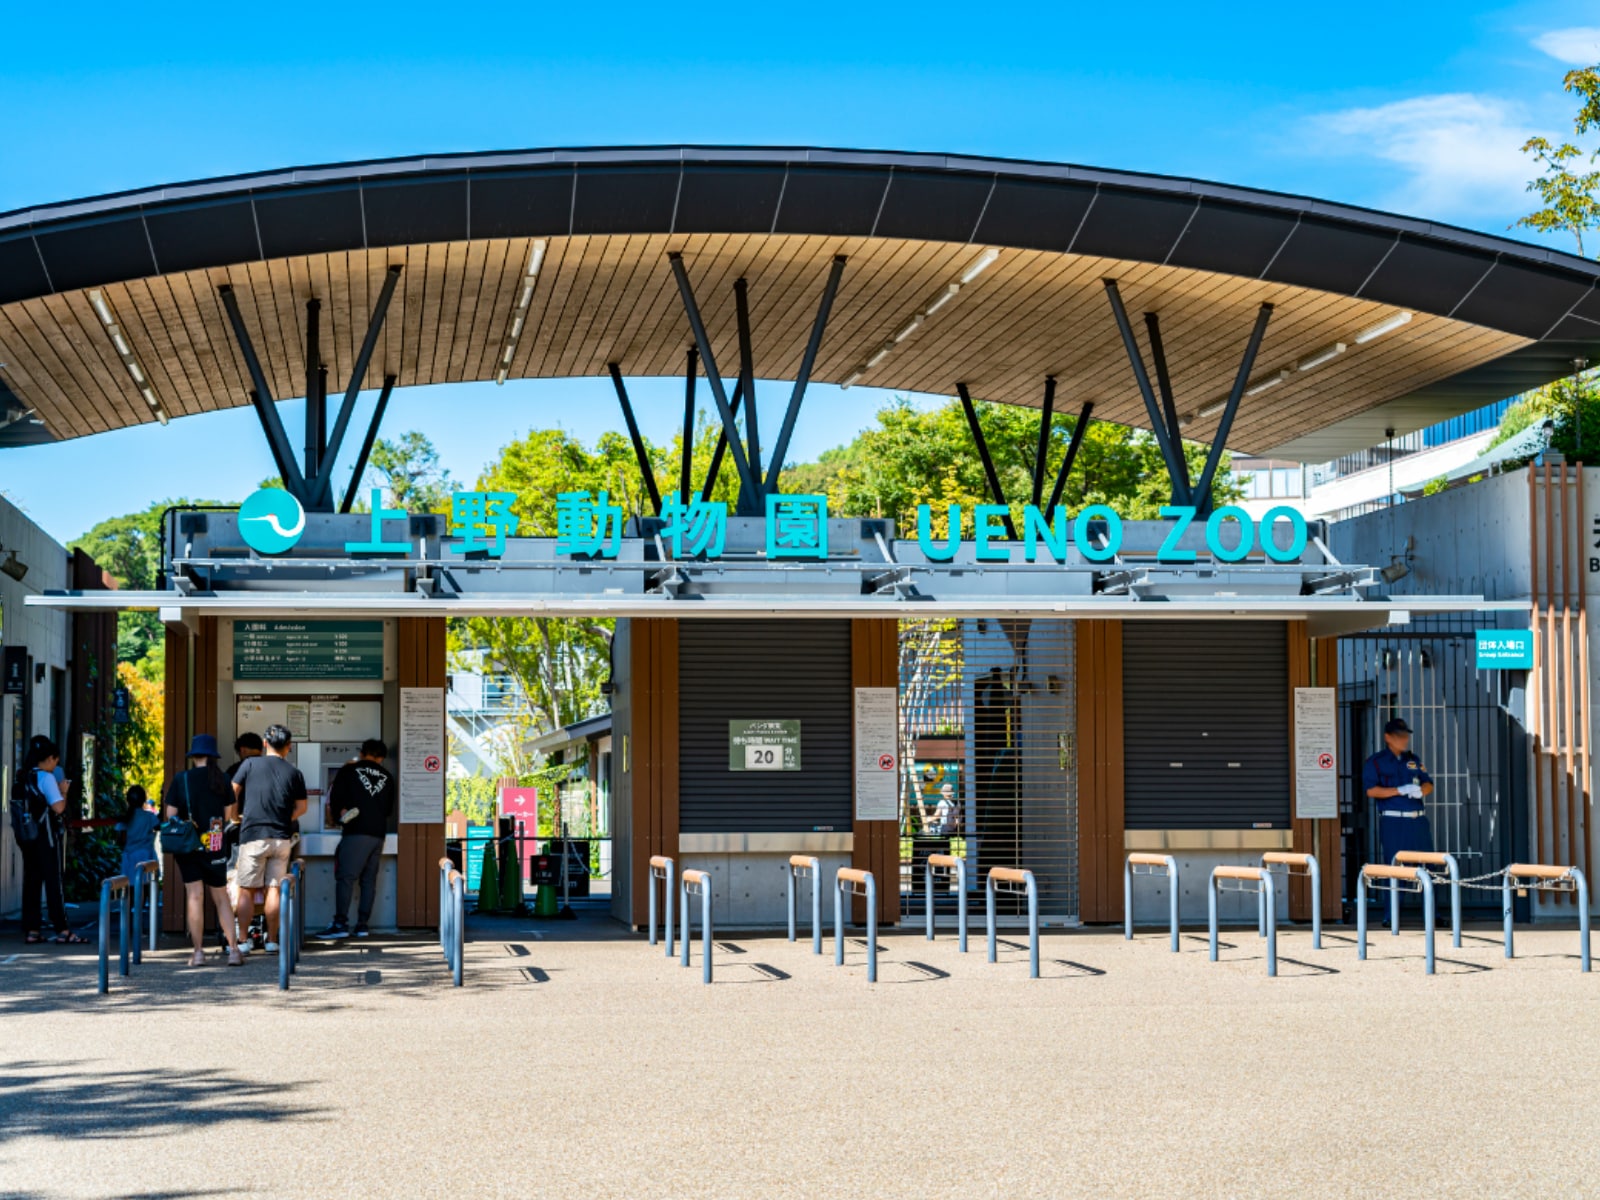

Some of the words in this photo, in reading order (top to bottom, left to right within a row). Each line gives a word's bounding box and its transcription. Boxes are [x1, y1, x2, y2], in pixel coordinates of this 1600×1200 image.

[344, 488, 829, 560] 上野動物園
[916, 503, 1123, 562] UENO
[1157, 504, 1308, 562] ZOO
[753, 749, 775, 765] 20
